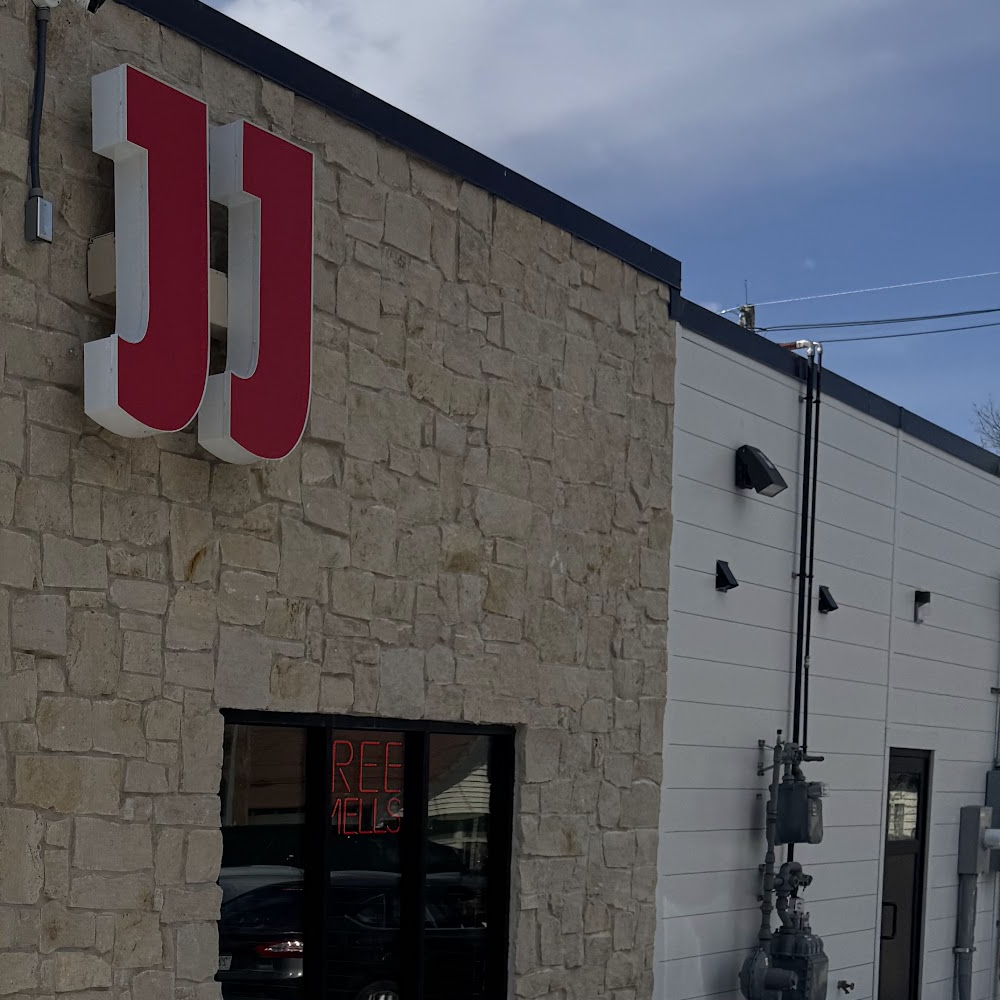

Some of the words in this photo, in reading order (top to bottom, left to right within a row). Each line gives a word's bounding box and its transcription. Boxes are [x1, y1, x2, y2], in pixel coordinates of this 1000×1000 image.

[116, 63, 315, 461] JJ
[330, 739, 403, 793] REE
[330, 797, 402, 835] ELLS
